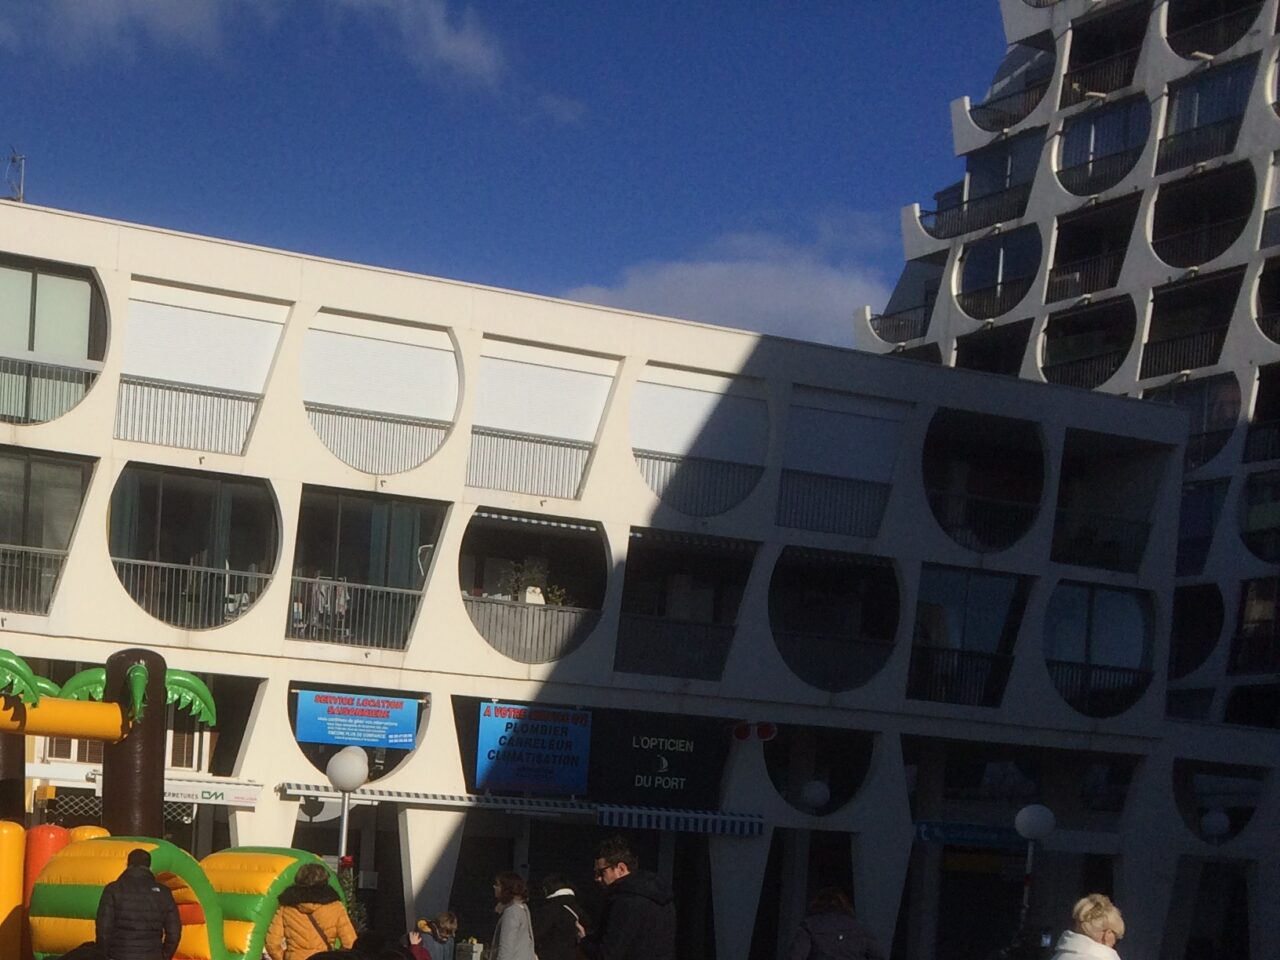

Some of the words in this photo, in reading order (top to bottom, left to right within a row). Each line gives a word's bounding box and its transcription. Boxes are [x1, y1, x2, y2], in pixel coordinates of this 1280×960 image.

[494, 706, 527, 720] VOTRE
[505, 722, 569, 737] PLOMBIER
[498, 735, 573, 751] CARRELEUR
[632, 735, 695, 752] L'OPTICIEN
[487, 749, 579, 767] CLIMATISATION
[634, 774, 652, 788] DU
[654, 776, 687, 790] PORT
[164, 791, 199, 800] ERMETURES
